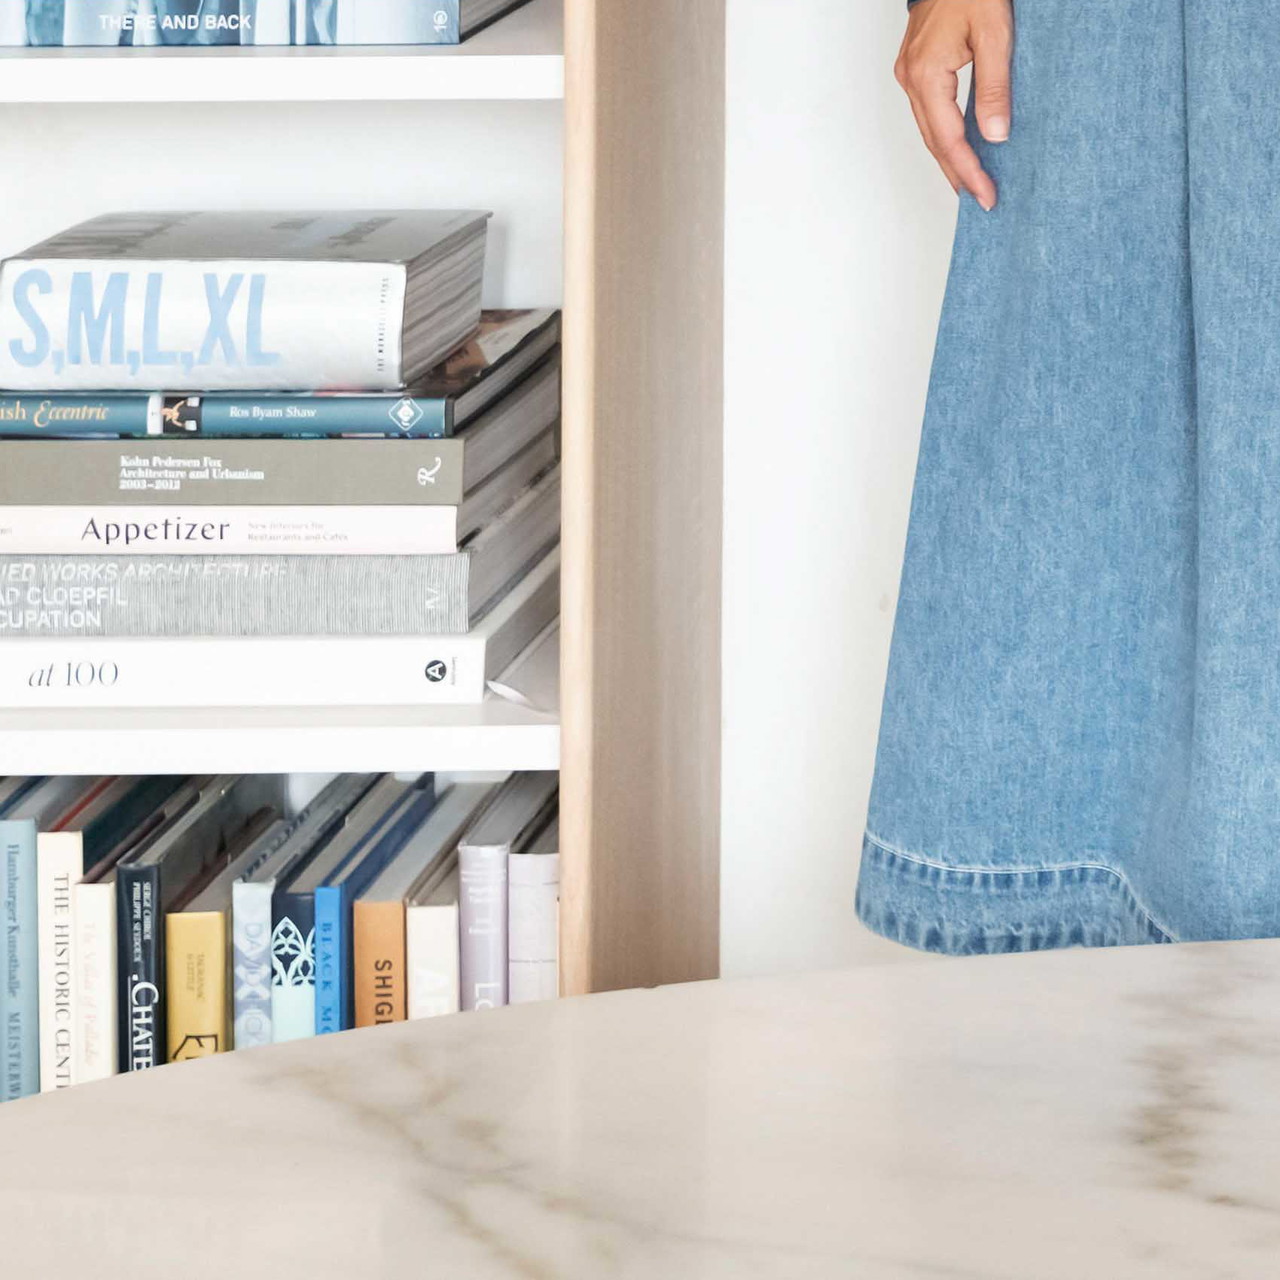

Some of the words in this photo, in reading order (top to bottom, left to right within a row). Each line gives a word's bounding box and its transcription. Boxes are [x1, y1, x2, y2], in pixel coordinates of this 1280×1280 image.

[161, 15, 199, 30] AND
[204, 15, 251, 30] BACK
[9, 269, 282, 376] S,M,L,XL
[33, 399, 110, 428] Eccentric
[229, 405, 249, 418] Ros
[252, 405, 283, 421] Byam
[286, 405, 317, 419] Shaw
[119, 467, 186, 479] Architecture
[188, 468, 209, 479] and
[212, 468, 265, 480] Urbanism
[120, 455, 149, 467] Kohn
[152, 455, 200, 467] Pedersen
[203, 456, 222, 467] Fox
[81, 516, 231, 545] Appetizer
[41, 563, 118, 582] WORKS
[26, 586, 128, 606] CLOEPFIL
[28, 661, 54, 688] at
[66, 661, 120, 687] 100
[54, 872, 70, 915] THE
[322, 922, 333, 991] BLACK
[54, 924, 71, 1021] HISTORIC
